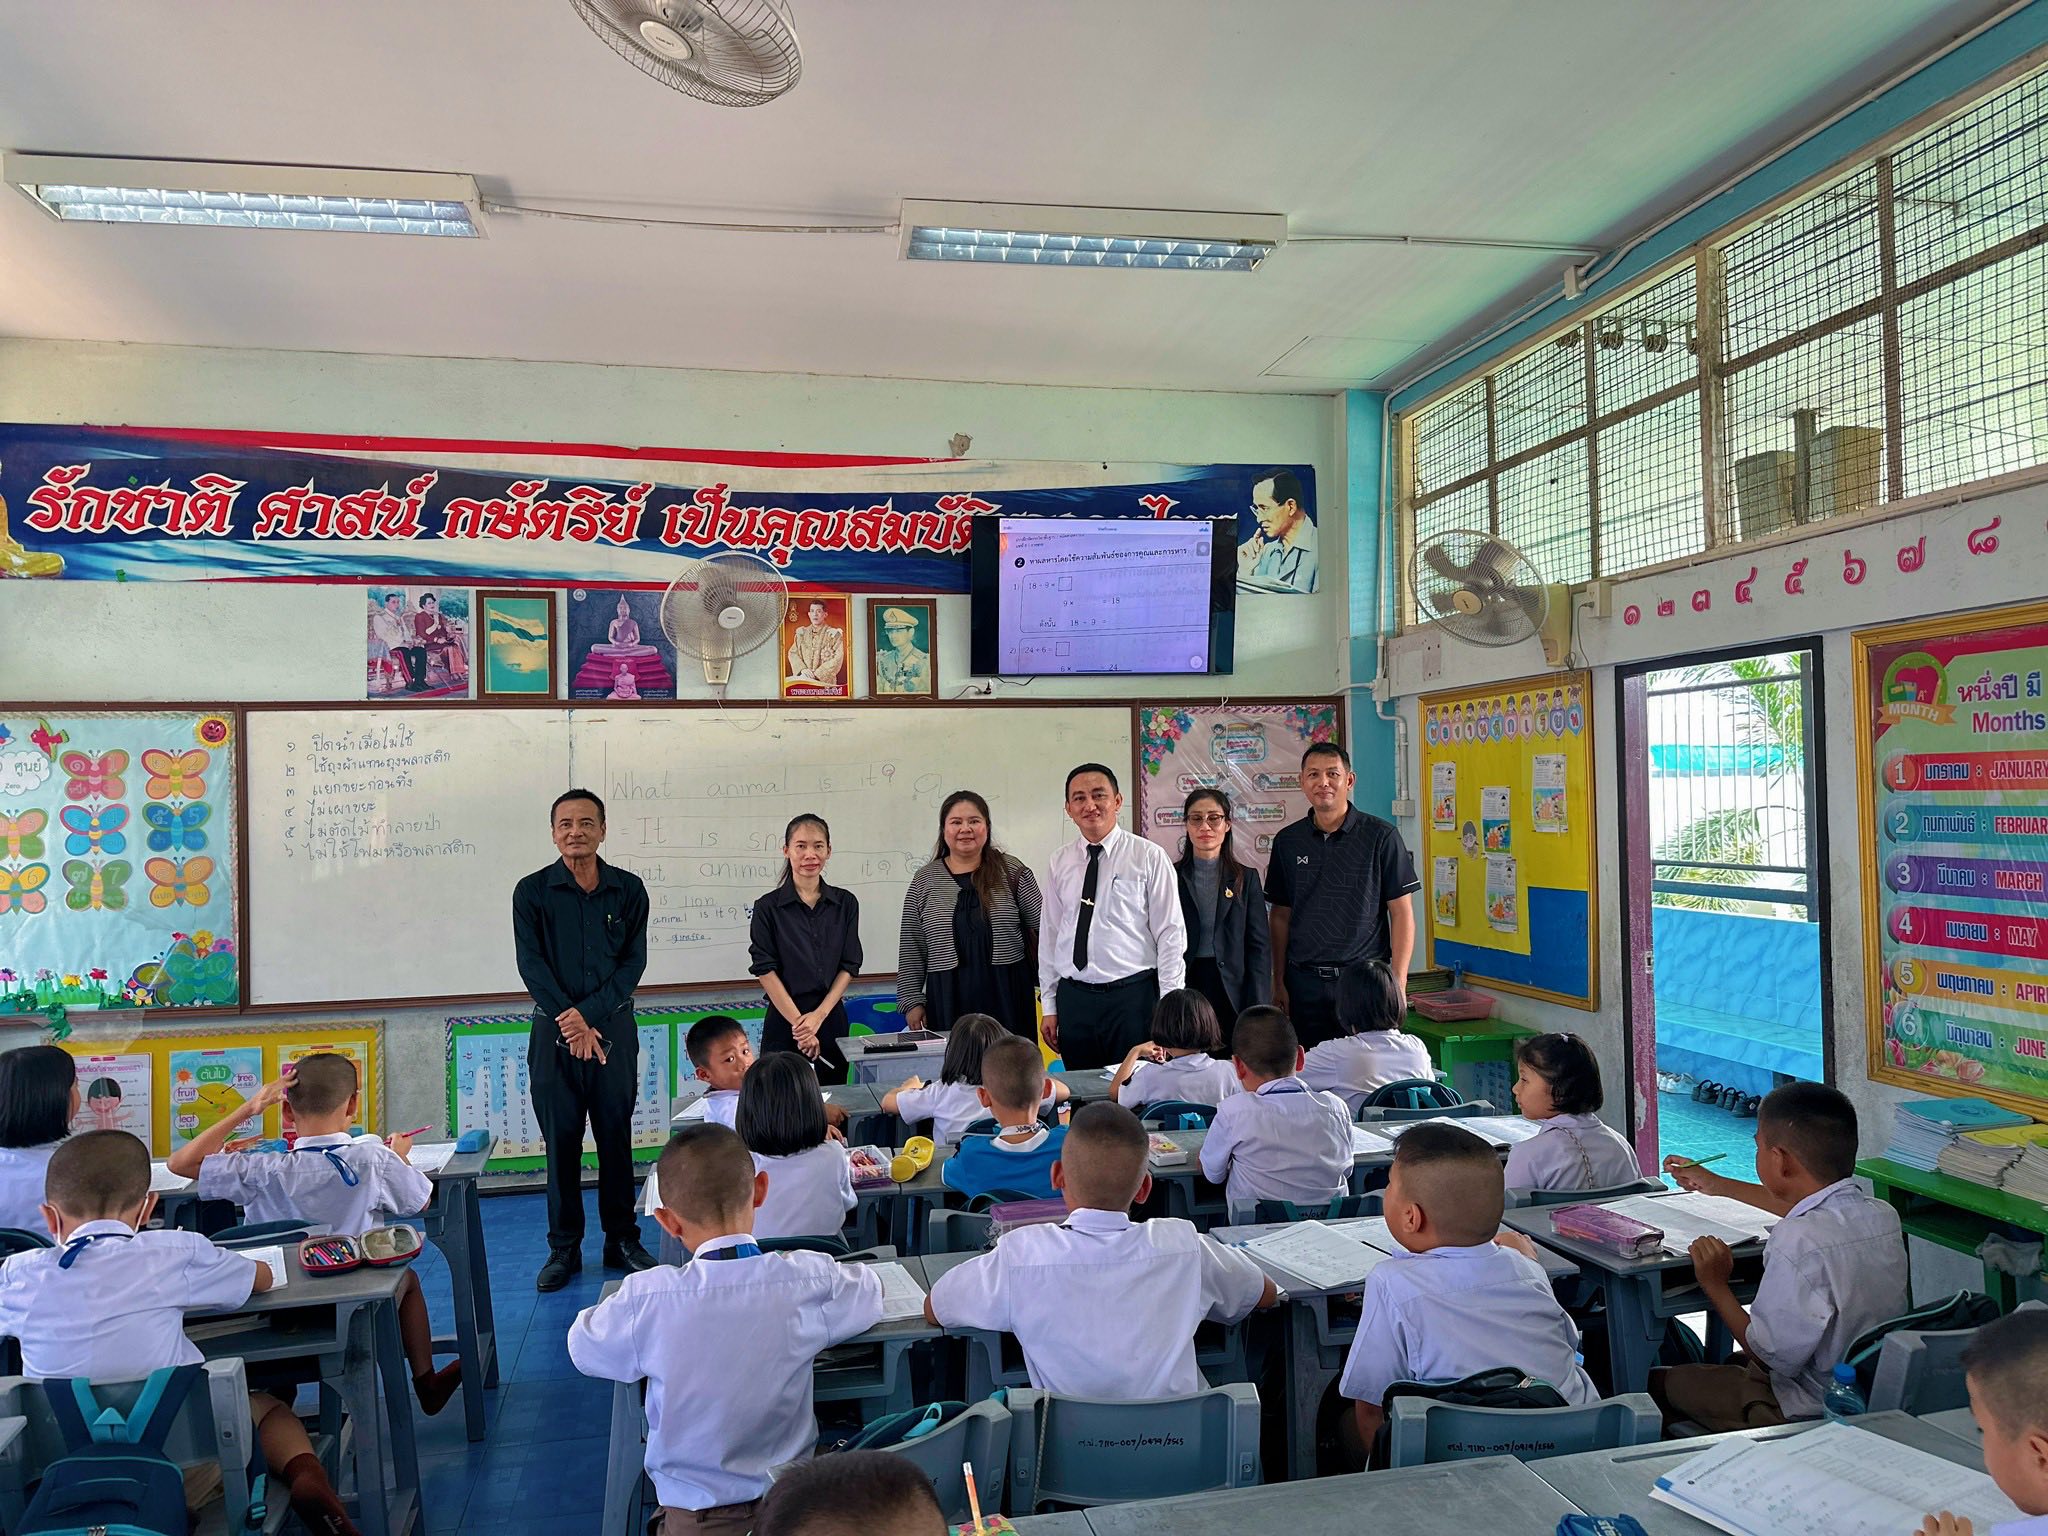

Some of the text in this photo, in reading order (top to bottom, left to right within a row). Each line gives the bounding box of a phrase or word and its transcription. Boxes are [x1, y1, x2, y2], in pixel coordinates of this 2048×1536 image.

[24, 463, 243, 537] รักชาติ
[253, 469, 440, 541] ศาสน์
[441, 477, 656, 547] กษัตริย์
[1623, 515, 2001, 625] ๑ ๒ ๓ ๔ ๕ ๖ ๗ ๘
[1957, 670, 2041, 703] หนึ่งปี มี
[1888, 702, 1940, 721] MONTH
[1972, 710, 2046, 734] Months
[14, 757, 42, 777] ศูนย์
[1895, 761, 1906, 784] 1
[1925, 763, 1970, 781] มกราคม
[611, 770, 672, 800] What
[707, 768, 787, 798] animal
[818, 776, 832, 792] is
[639, 815, 667, 846] It
[701, 830, 718, 847] is
[1895, 812, 1909, 834] 2
[27, 869, 38, 885] 6
[109, 867, 121, 884] 7
[699, 858, 779, 880] animal
[1896, 862, 1911, 885] 3
[1937, 864, 1976, 887] มีนาคม
[1995, 871, 2044, 893] MARCH
[660, 894, 714, 908] is lion
[653, 910, 687, 924] animal
[700, 910, 709, 919] is
[651, 933, 660, 943] is
[1899, 912, 1912, 935] 4
[1946, 920, 1989, 942] เมษายน
[2008, 926, 2039, 948] MAY
[1900, 962, 1915, 985] 5
[1937, 972, 1995, 996] พฤษภาคม
[1902, 1012, 1916, 1036] 6
[1945, 1020, 1993, 1050] มิถุนายน
[2014, 1038, 2047, 1059] JUNE
[200, 1067, 227, 1081] ต้นไม้
[177, 1088, 197, 1098] fruit
